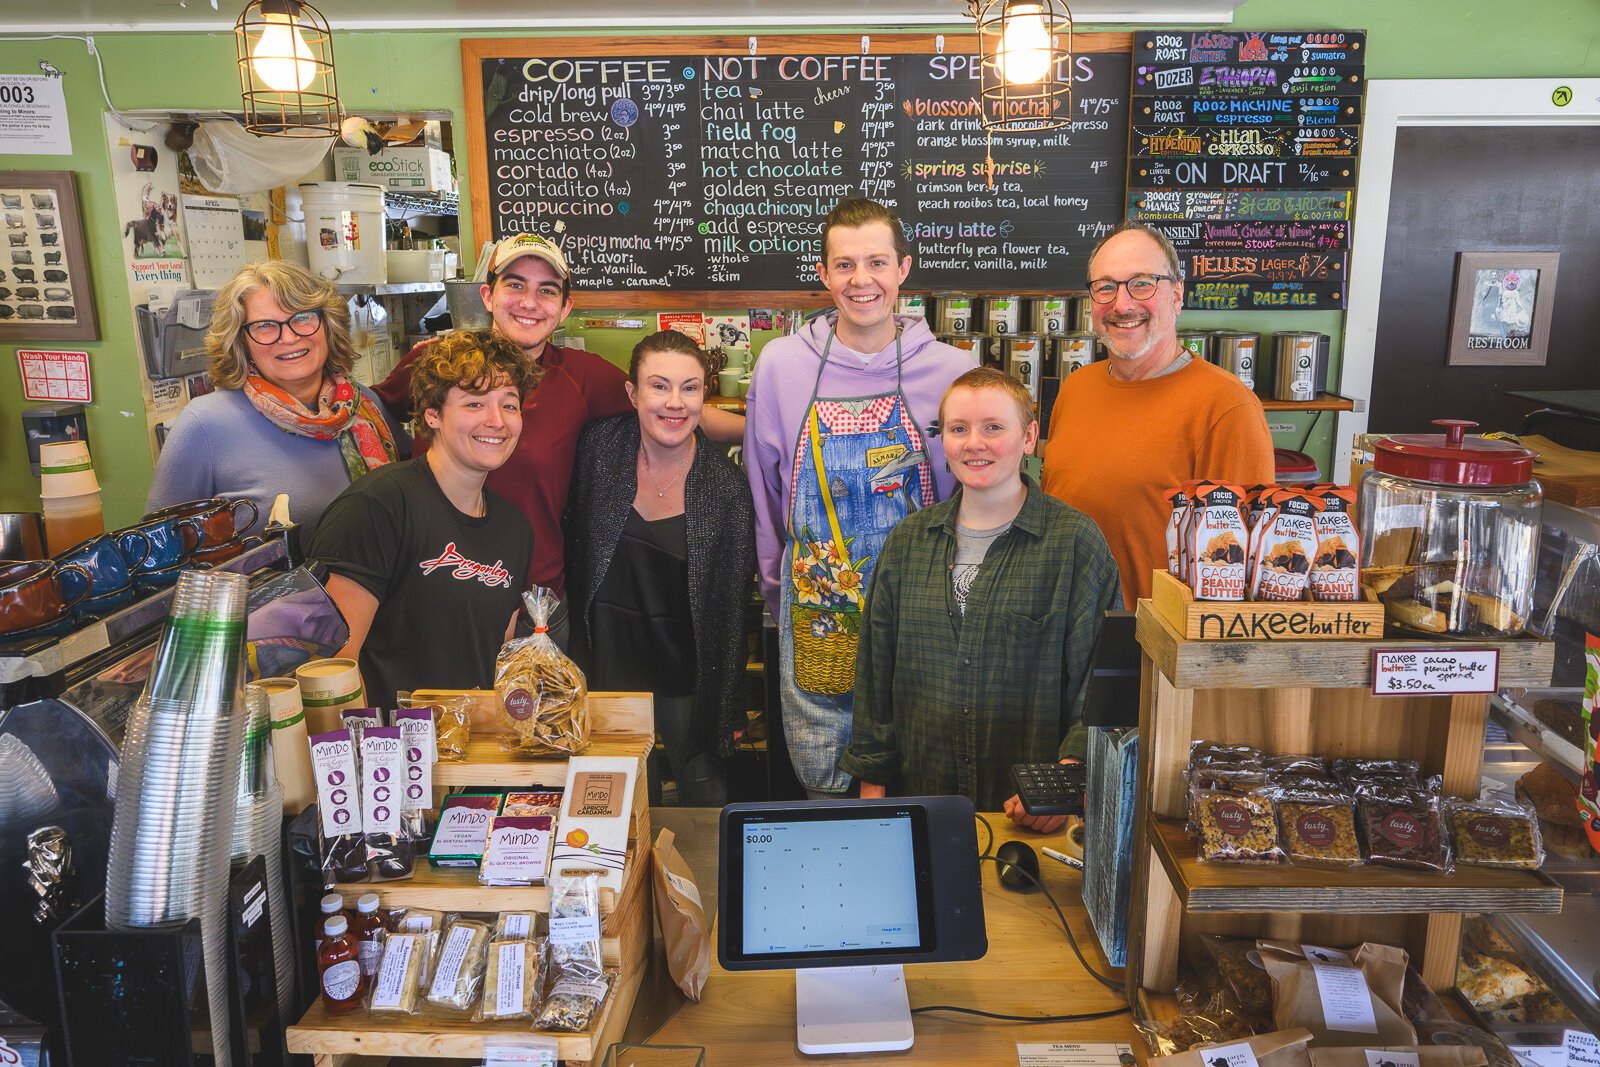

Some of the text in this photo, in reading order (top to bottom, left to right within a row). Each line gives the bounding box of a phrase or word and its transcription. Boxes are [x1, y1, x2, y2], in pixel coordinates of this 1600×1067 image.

[1155, 48, 1187, 60] ROAST
[1311, 51, 1346, 60] sumatra
[523, 59, 671, 84] COFFEE
[704, 56, 892, 81] NOT COFFEE
[1158, 68, 1192, 87] DOZER
[519, 83, 631, 106] drip/long pull
[702, 82, 742, 100] tea
[814, 85, 851, 106] cheers
[1290, 84, 1336, 94] guji region
[510, 103, 608, 124] cold brew
[701, 102, 805, 120] chai latte
[992, 99, 1050, 116] mocha
[1230, 100, 1293, 113] MACHINE
[1154, 111, 1185, 123] ROAST
[1216, 114, 1272, 125] espresso
[1306, 115, 1336, 125] Blend
[917, 119, 945, 131] dark
[494, 128, 594, 145] espresso
[601, 126, 630, 142] (2oz)
[706, 122, 797, 143] field fog
[917, 134, 1071, 148] orange blossom syrup, milk
[1150, 137, 1200, 152] HYPERION
[494, 143, 636, 160] macchiato (2oz)
[701, 141, 842, 159] matcha latte
[369, 156, 424, 172] ecoStick
[497, 162, 578, 180] cortado
[585, 162, 614, 178] (4oz)
[703, 160, 843, 178] hot chocolate
[914, 160, 966, 180] spring
[1176, 162, 1207, 184] ON
[1224, 162, 1287, 184] DRAFT
[498, 181, 599, 198] cortadito
[604, 180, 632, 197] (4oz)
[704, 179, 854, 200] golden steamer
[916, 182, 1024, 194] crimson tea,
[498, 200, 614, 218] cappuccino
[704, 198, 812, 218] chaga chicory
[918, 195, 1088, 212] peach rooibos tea, local honey
[1138, 212, 1184, 220] kombucha
[500, 216, 550, 233] latte
[708, 218, 738, 234] add
[914, 222, 998, 240] fairy latte
[1207, 224, 1272, 238] Vanilla Crack
[610, 234, 652, 250] mocha
[704, 236, 822, 254] milk options
[581, 250, 634, 264] flavor:
[918, 242, 1070, 258] butterfly pea flower tea,
[132, 262, 155, 270] Support
[711, 254, 750, 264] whole
[919, 258, 1048, 270] lavender, vanilla, milk
[1261, 258, 1299, 270] LAGER
[603, 264, 648, 274] vanilla
[712, 264, 727, 272] 2%
[134, 270, 182, 282] Everything
[578, 276, 672, 288] maple caramel
[712, 272, 740, 282] skim
[1468, 337, 1529, 349] RESTROOM
[1288, 500, 1310, 510] FOCUS
[1206, 520, 1230, 530] butter
[1202, 578, 1244, 588] PEANUT
[1309, 572, 1354, 584] CACAO
[1202, 588, 1245, 598] BUTTER
[1423, 656, 1456, 664] cacao
[1424, 664, 1455, 676] peanut
[1459, 662, 1488, 672] butter
[510, 697, 530, 706] tasty
[1221, 810, 1246, 824] tasty
[1304, 820, 1329, 834] tasty
[1389, 820, 1418, 834] tasty
[1474, 824, 1502, 836] tasty
[746, 834, 772, 844] $0.00
